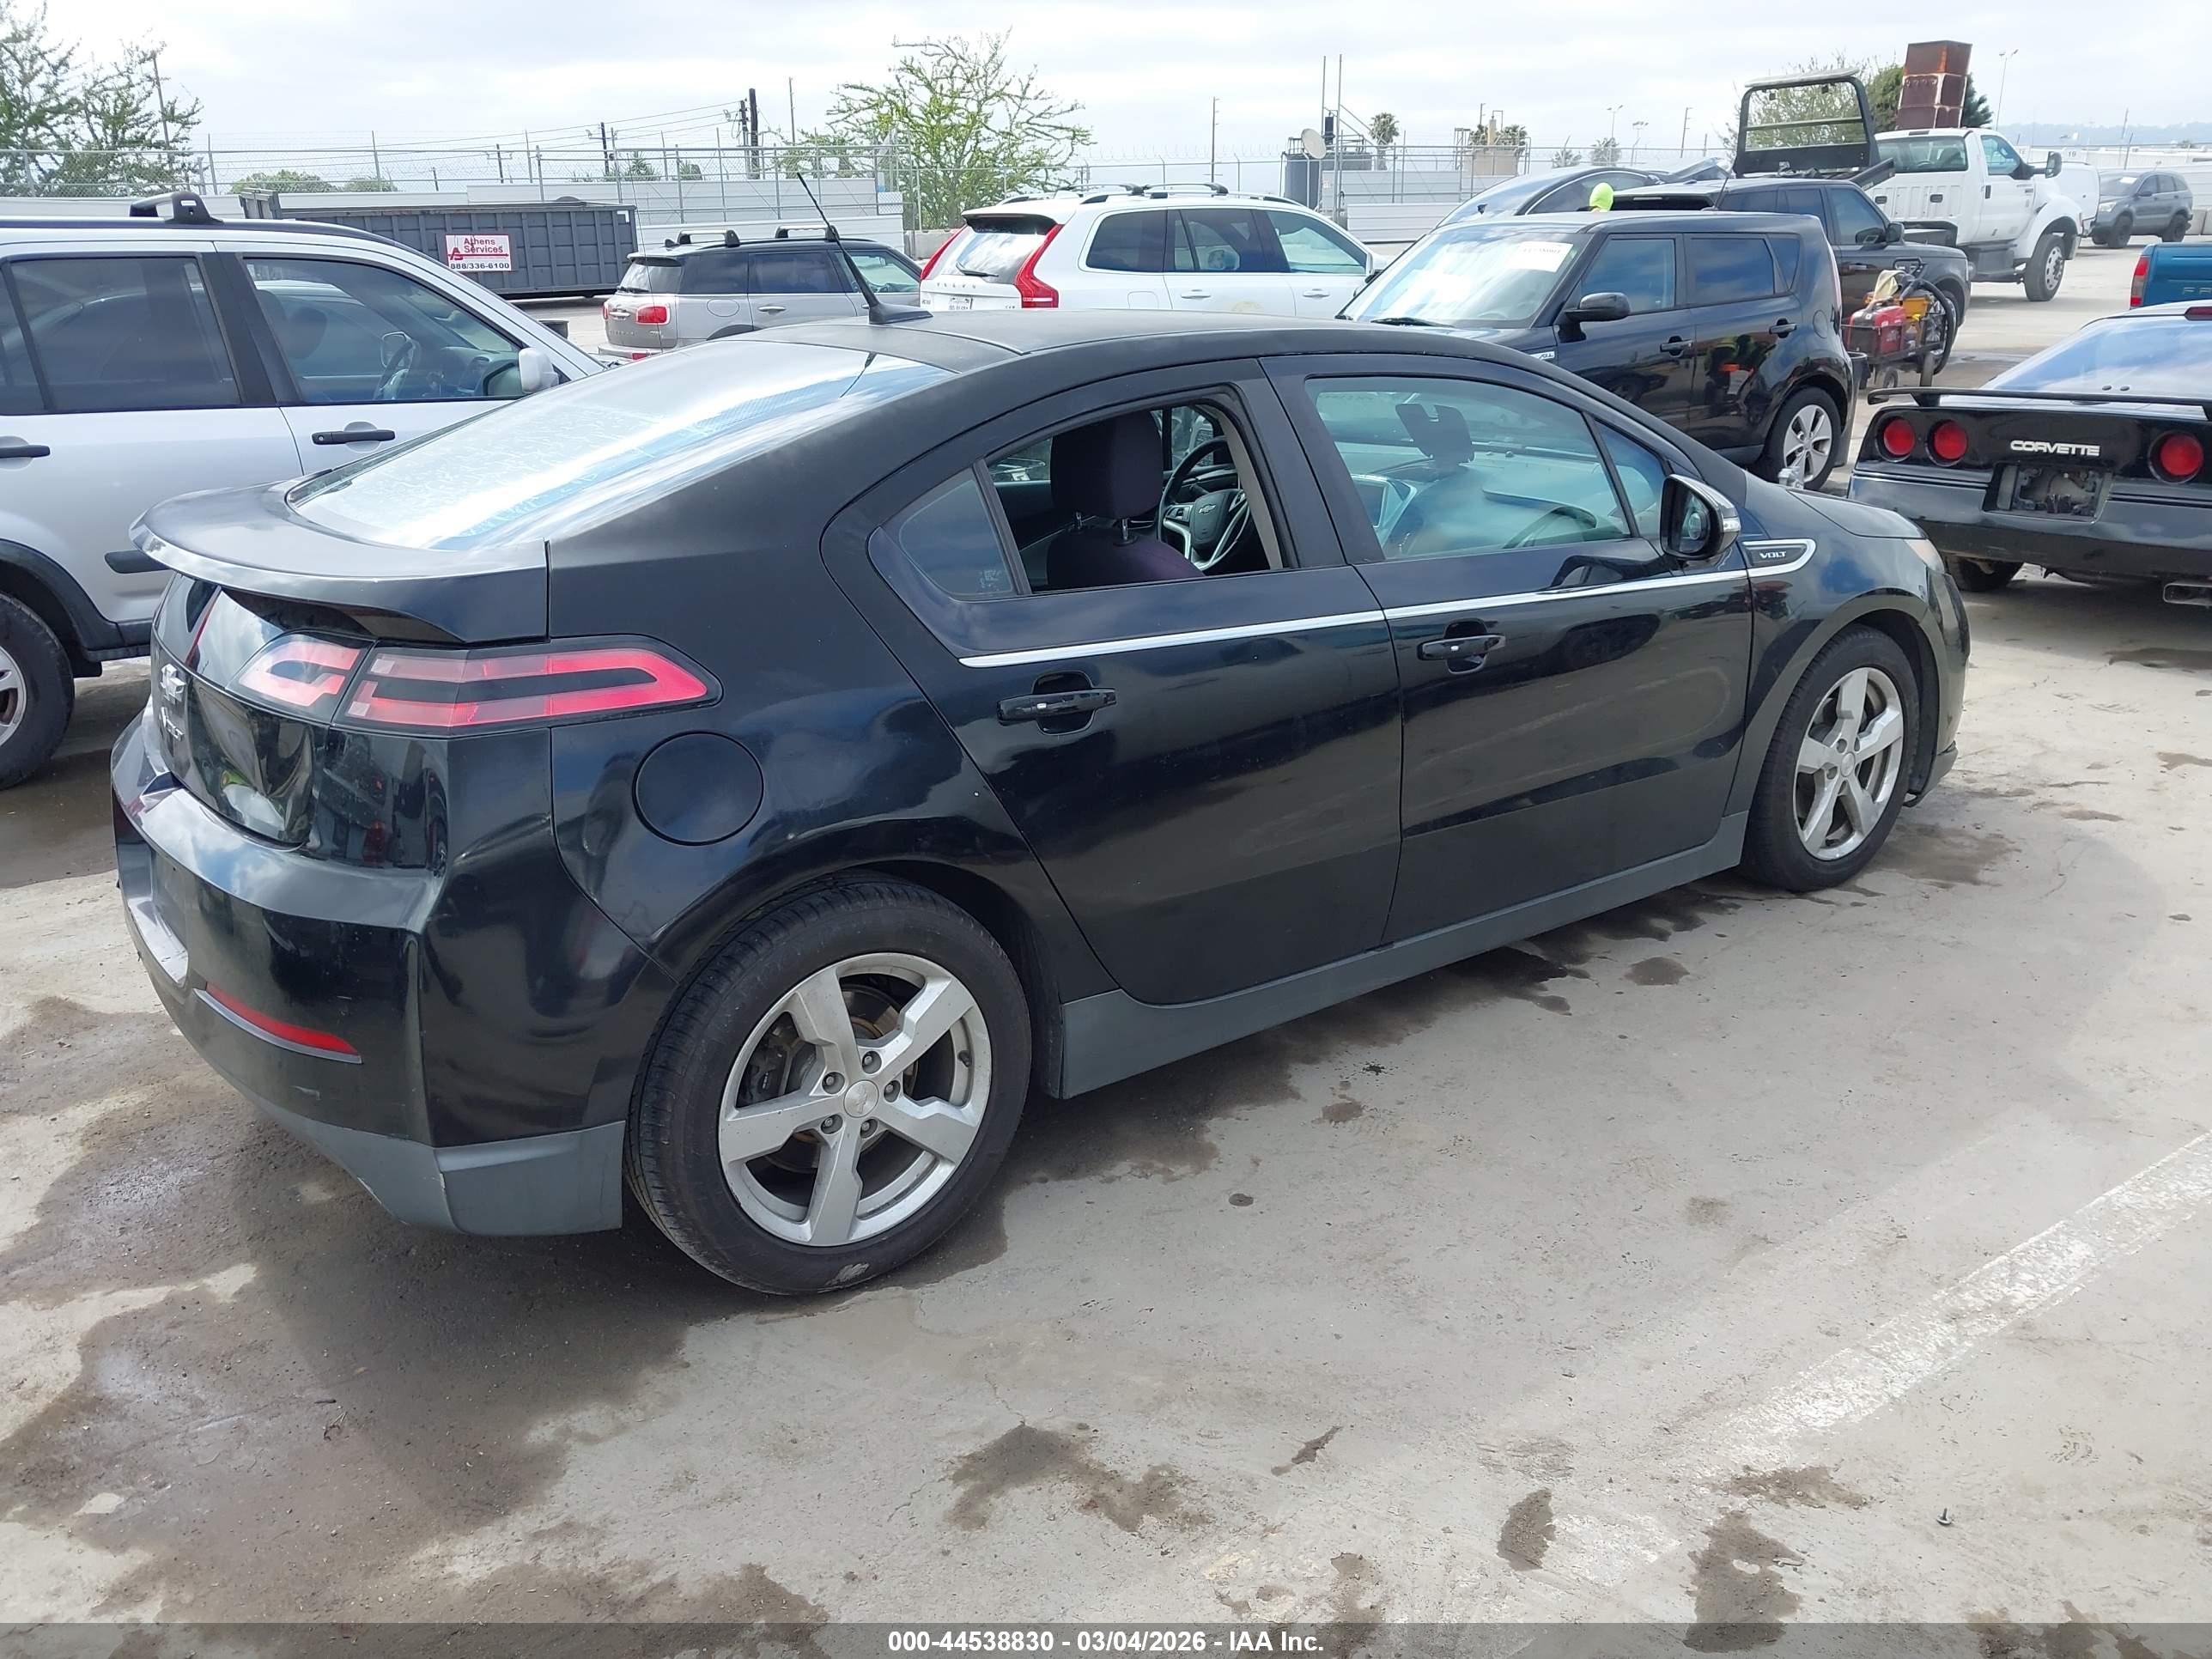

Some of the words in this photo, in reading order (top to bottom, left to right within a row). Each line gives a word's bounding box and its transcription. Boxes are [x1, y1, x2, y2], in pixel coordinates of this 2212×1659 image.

[464, 246, 504, 254] Services
[2010, 440, 2101, 457] CORVETTE
[1759, 550, 1787, 559] VOLT
